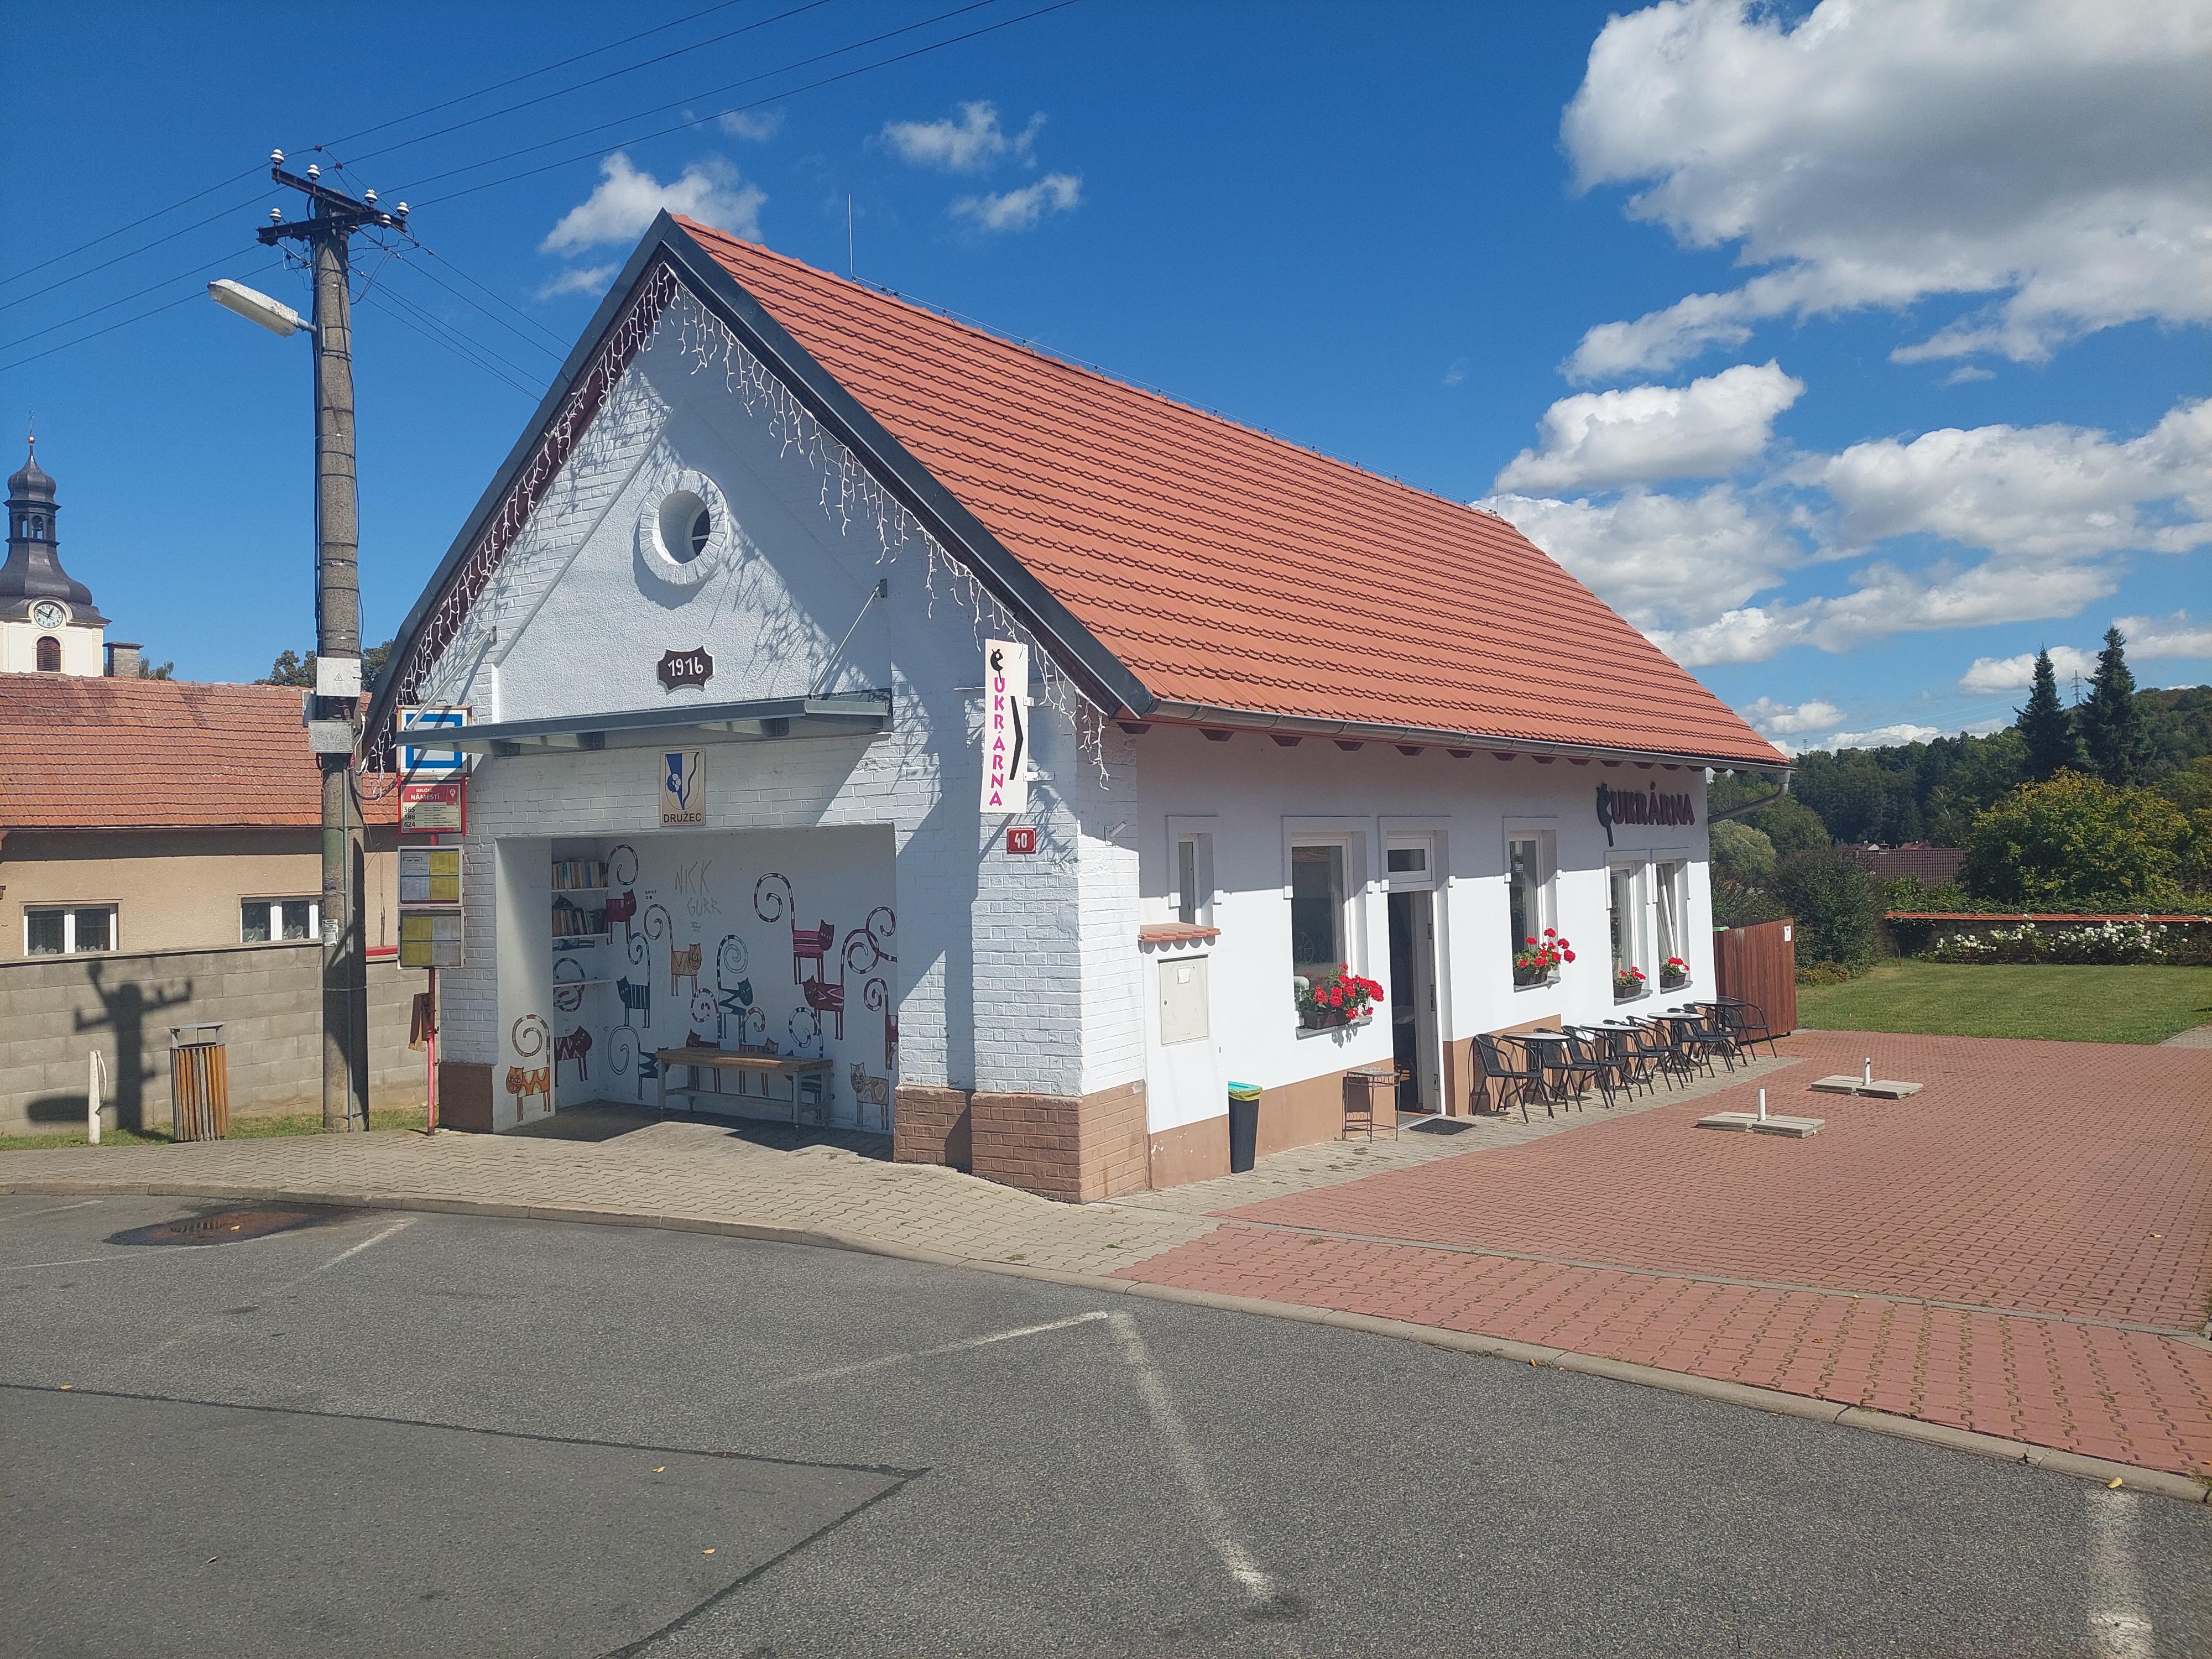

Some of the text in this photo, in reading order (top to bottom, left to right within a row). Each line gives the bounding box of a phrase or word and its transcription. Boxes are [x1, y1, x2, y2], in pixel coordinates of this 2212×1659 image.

[667, 656, 703, 676] 1916
[664, 810, 702, 823] DRUŽEC
[1014, 833, 1027, 848] 40
[675, 860, 712, 895] NICK
